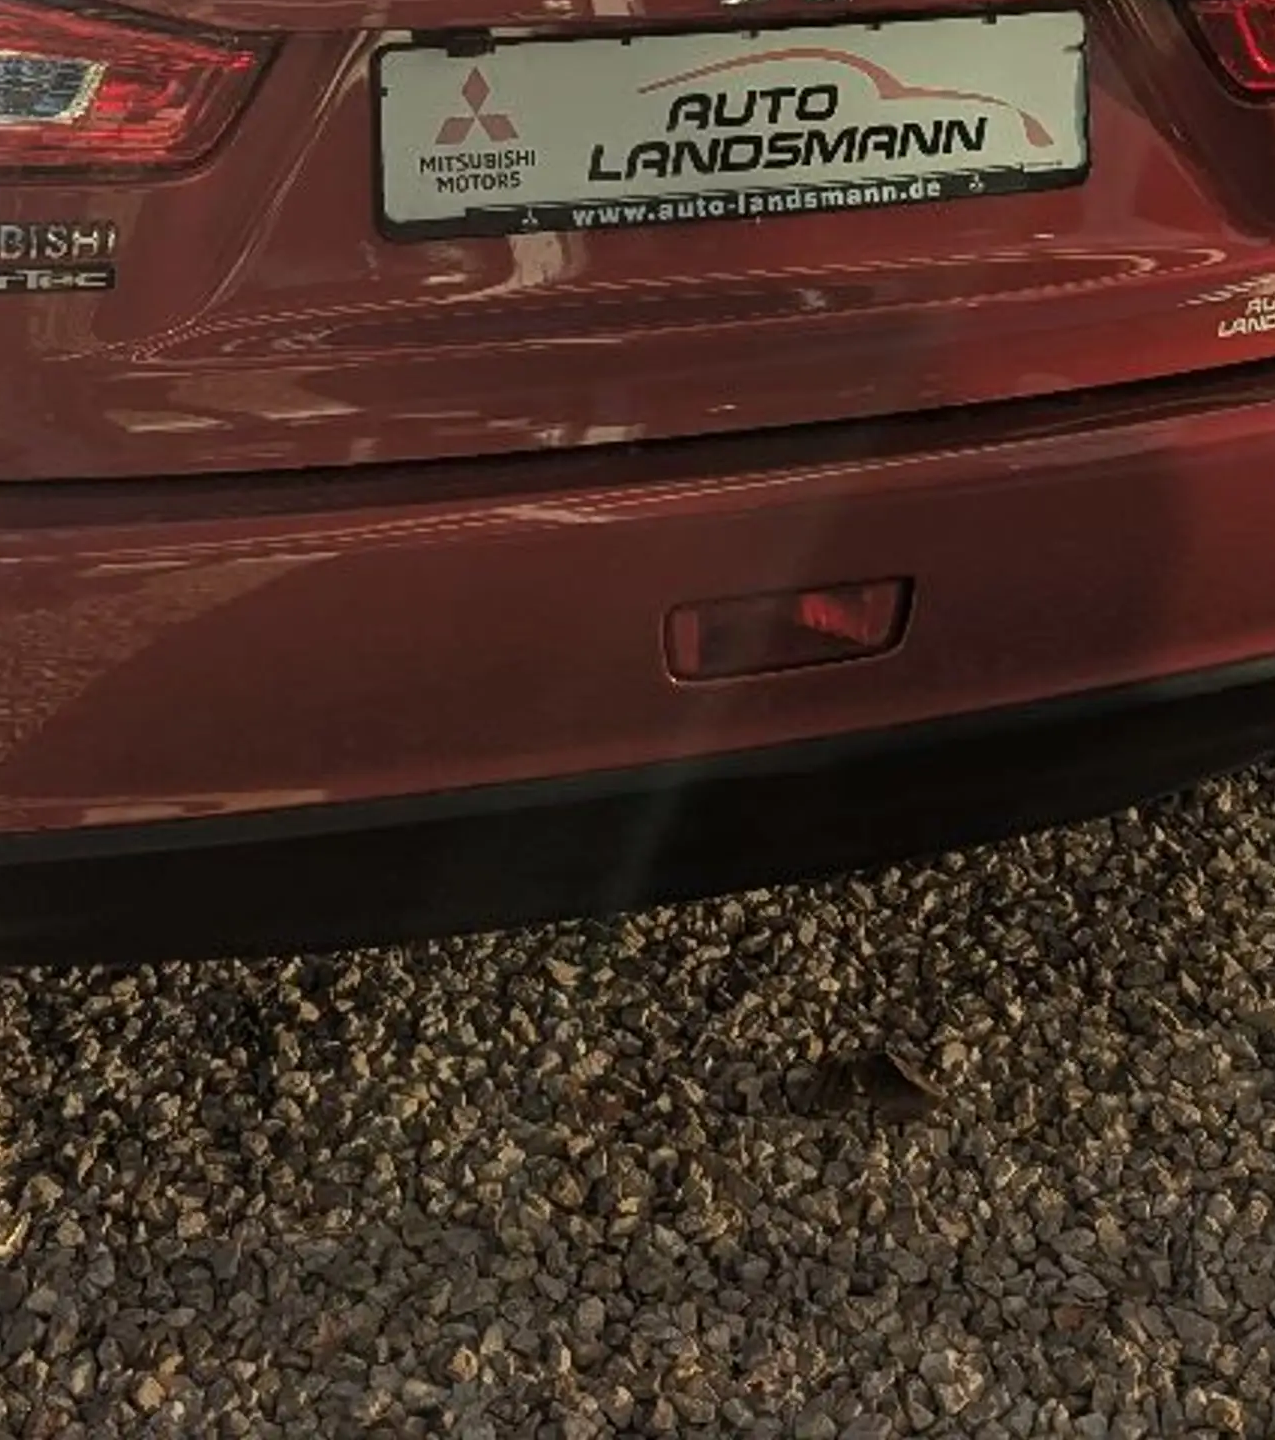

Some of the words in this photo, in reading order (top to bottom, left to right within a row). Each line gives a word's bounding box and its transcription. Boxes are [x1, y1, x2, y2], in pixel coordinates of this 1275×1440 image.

[666, 84, 840, 131] AUTO
[419, 149, 536, 175] MITSUBISHI
[588, 117, 988, 182] LANDSMANN
[436, 171, 522, 193] MOTORS
[572, 179, 942, 227] www.auto-landsmann.de
